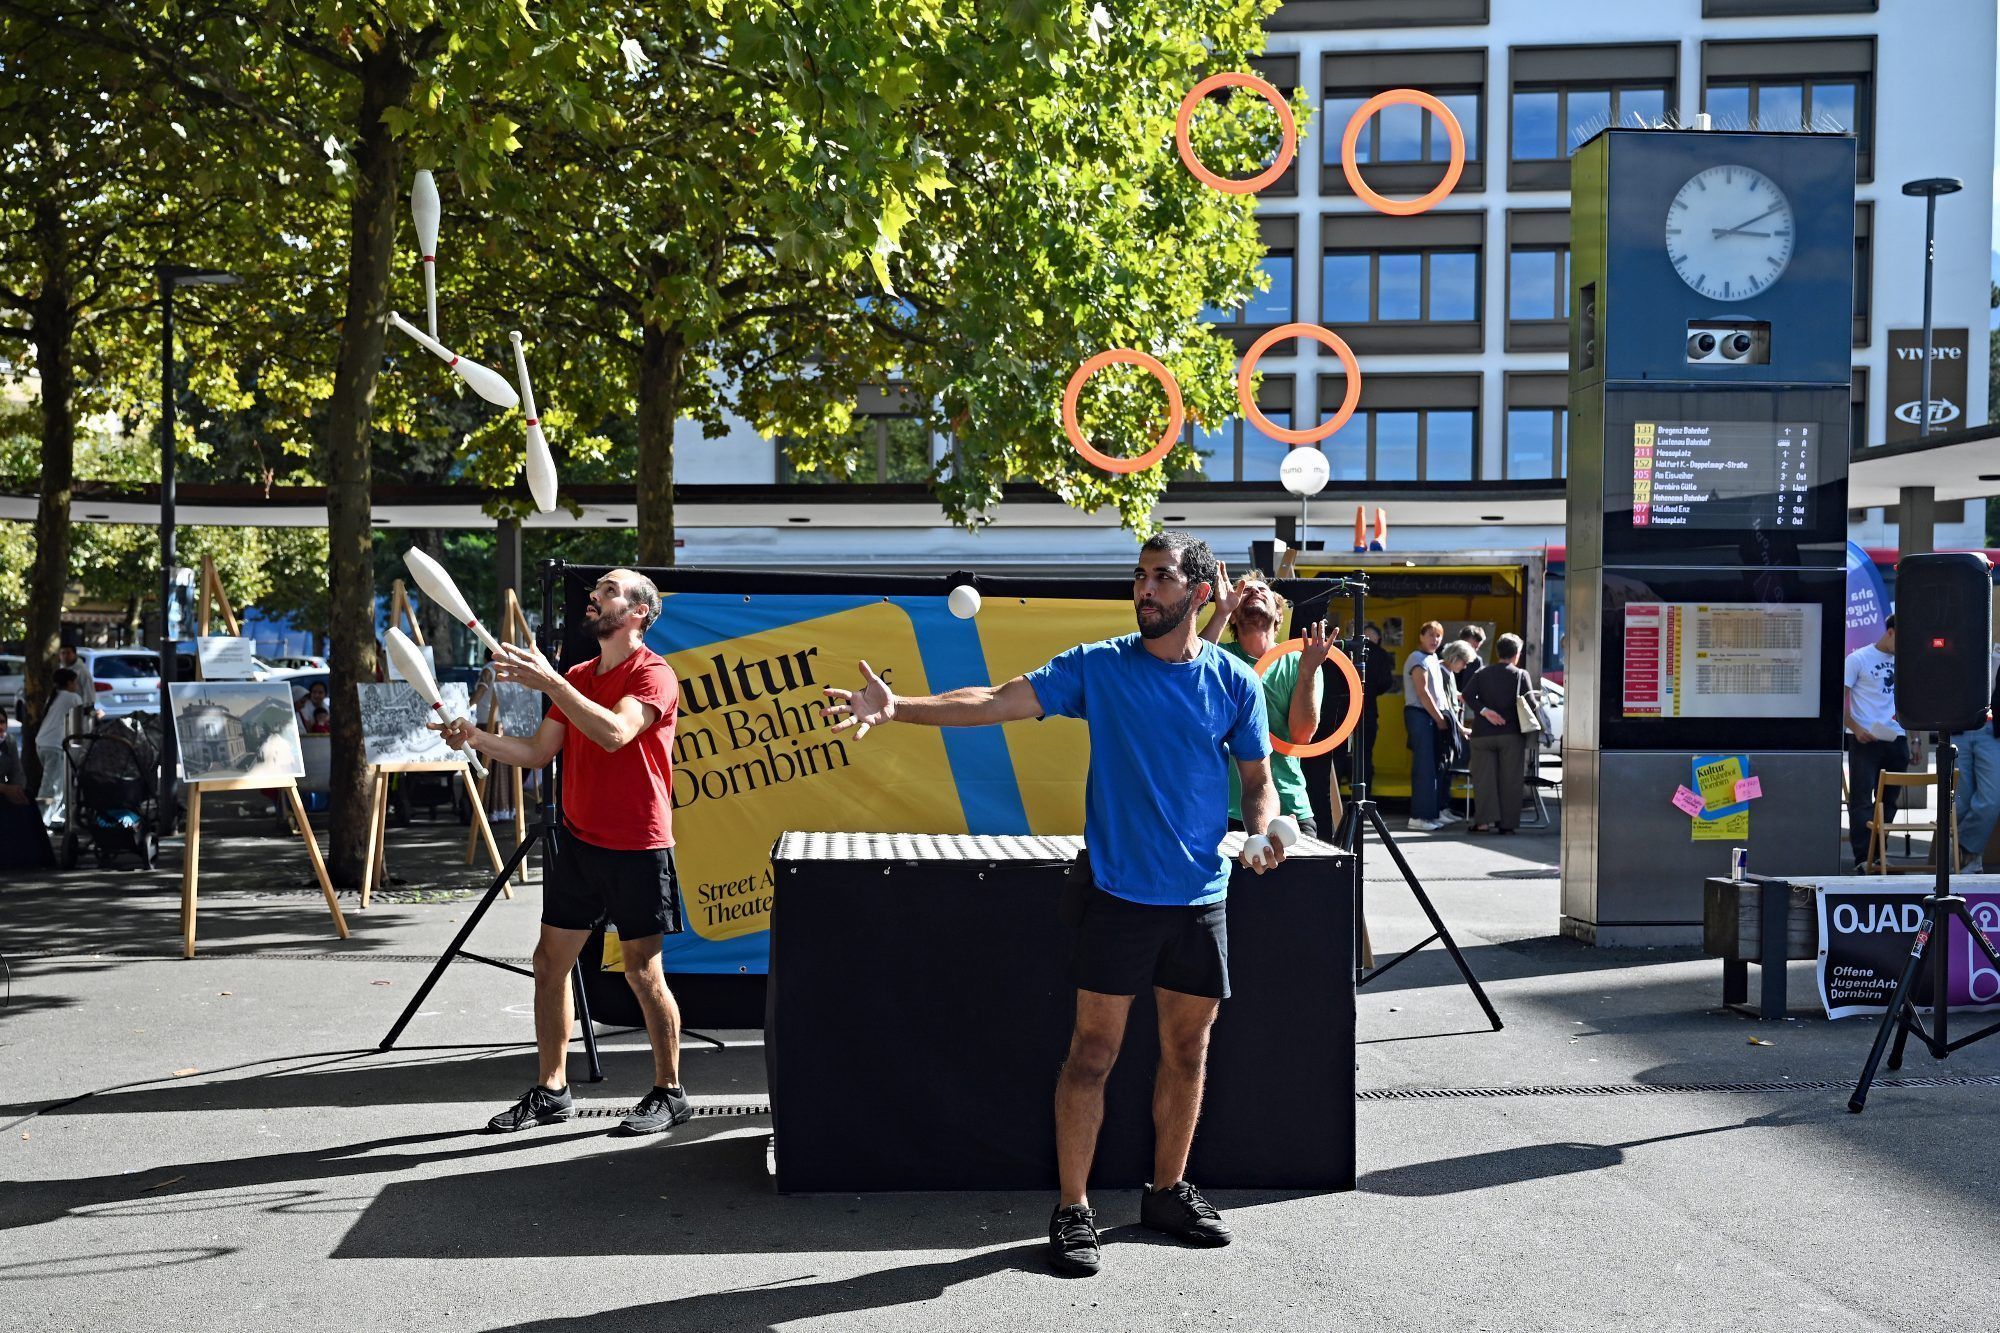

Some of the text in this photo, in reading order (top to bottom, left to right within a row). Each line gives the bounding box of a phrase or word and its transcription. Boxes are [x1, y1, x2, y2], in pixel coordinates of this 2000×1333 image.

[1897, 346, 1961, 360] vivere
[1658, 426, 1682, 435] Bregenz
[1684, 426, 1709, 435] Bahnhof
[1637, 437, 1651, 445] 162
[1657, 437, 1685, 446] Lustenau
[1686, 438, 1711, 446] Bahnhof
[1634, 448, 1650, 456] 211
[1656, 449, 1691, 458] Messeplatz
[1634, 471, 1649, 479] 205
[1654, 482, 1680, 491] Dornbirn
[1683, 494, 1709, 502] Bahnhof
[1652, 516, 1686, 525] Messeplatz
[676, 646, 817, 717] ultur
[672, 739, 850, 810] Dornbirn
[1697, 764, 1725, 778] Kultur
[698, 874, 757, 904] Street
[1833, 904, 1925, 934] OJAD
[1833, 966, 1874, 977] Offene
[1831, 989, 1882, 999] Dornbirn
